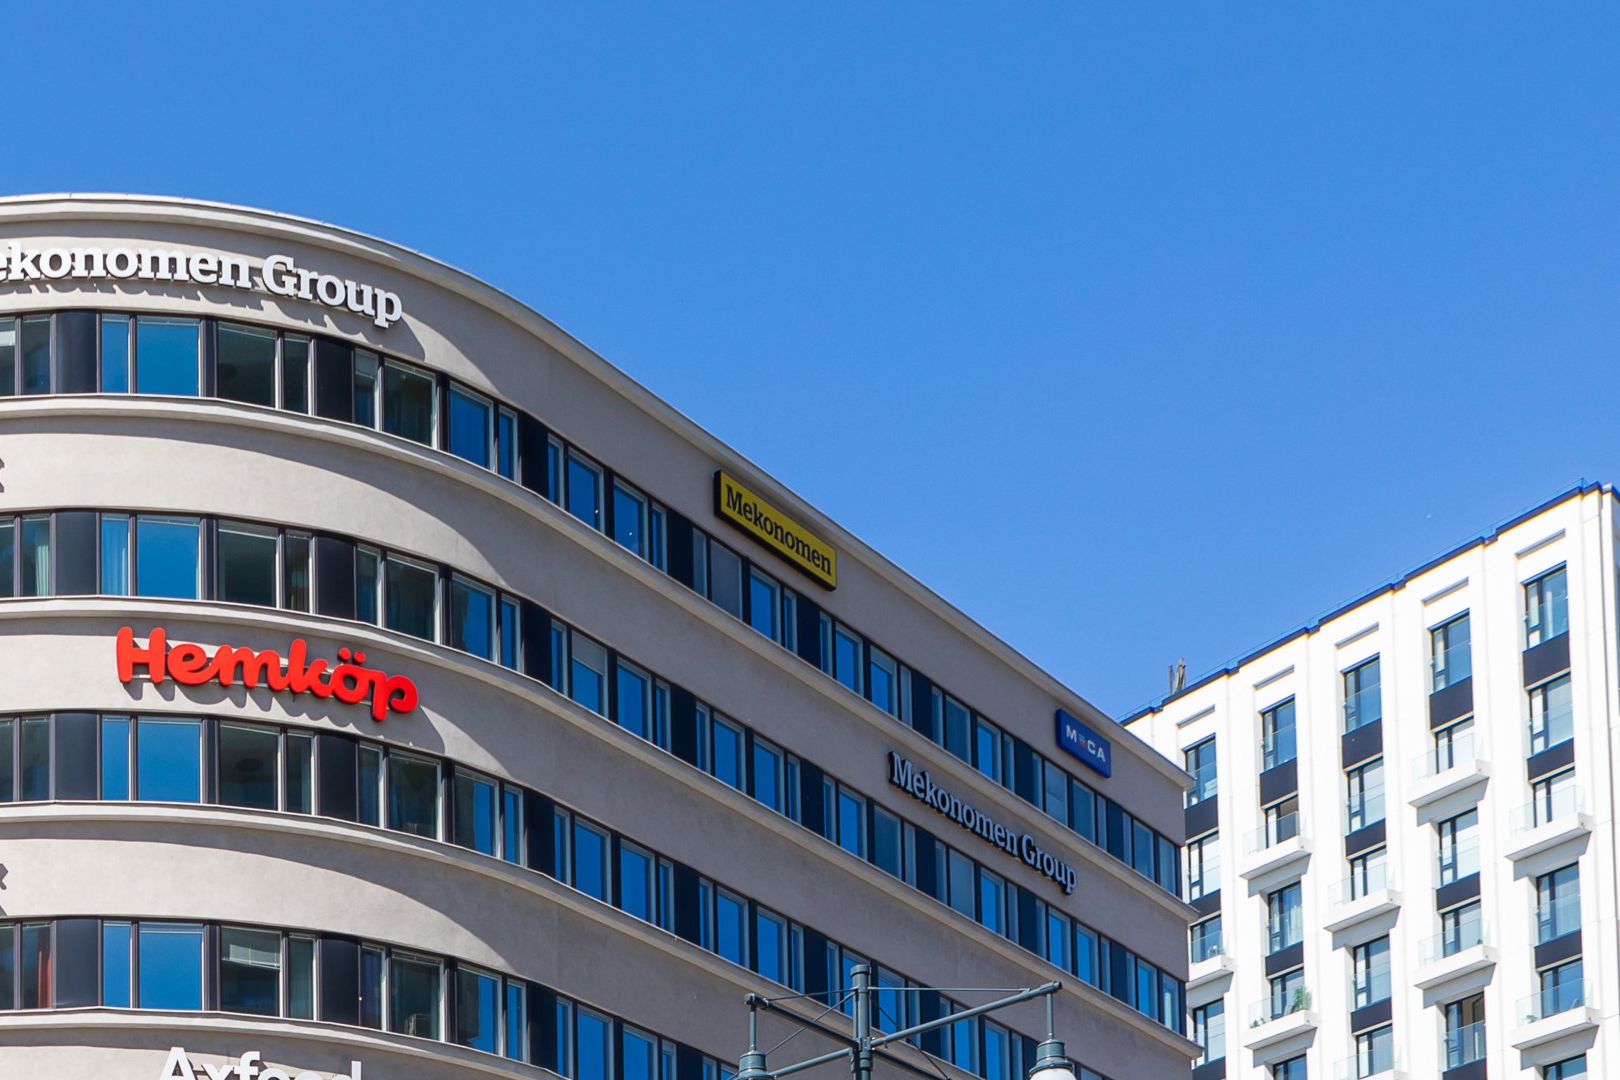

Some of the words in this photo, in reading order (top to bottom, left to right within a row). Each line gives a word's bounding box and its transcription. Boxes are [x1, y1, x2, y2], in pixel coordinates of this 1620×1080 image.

[261, 254, 403, 329] Group
[725, 483, 832, 577] Mekonomen
[116, 626, 419, 722] Hemköp
[889, 750, 1019, 856] Mekonomen
[1021, 832, 1078, 895] Group
